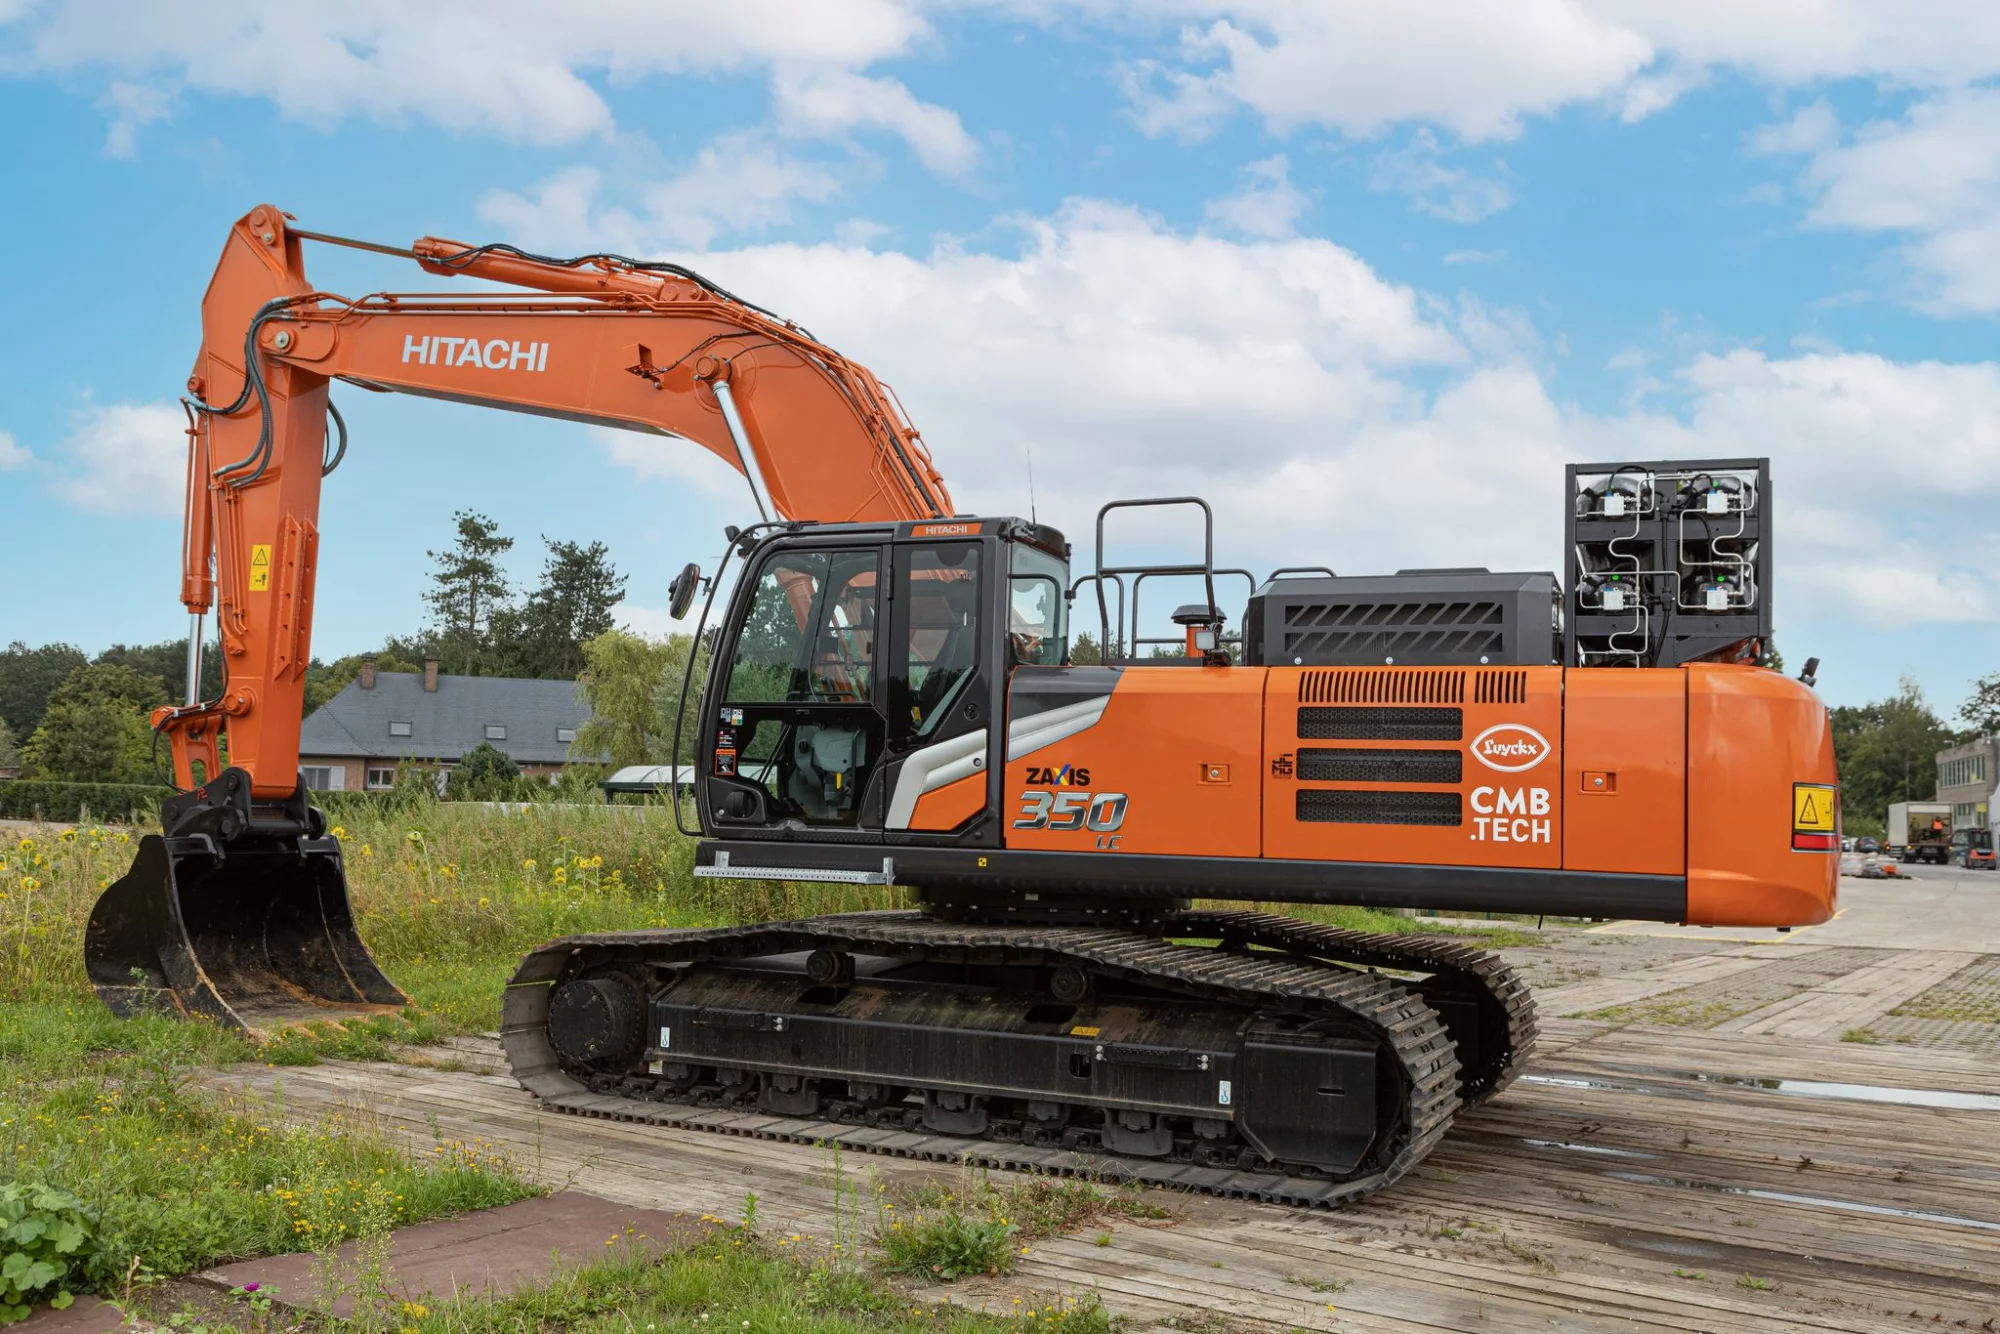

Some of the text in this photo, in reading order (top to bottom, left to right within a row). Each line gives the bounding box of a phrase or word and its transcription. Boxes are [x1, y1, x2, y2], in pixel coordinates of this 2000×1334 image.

[402, 335, 549, 371] HITACHI
[925, 525, 967, 535] HITACHI
[1026, 764, 1091, 786] ZAXIS
[1013, 791, 1129, 832] 350
[1470, 786, 1550, 815] CMB
[1096, 835, 1122, 849] LC
[1470, 817, 1550, 843] .TECH
